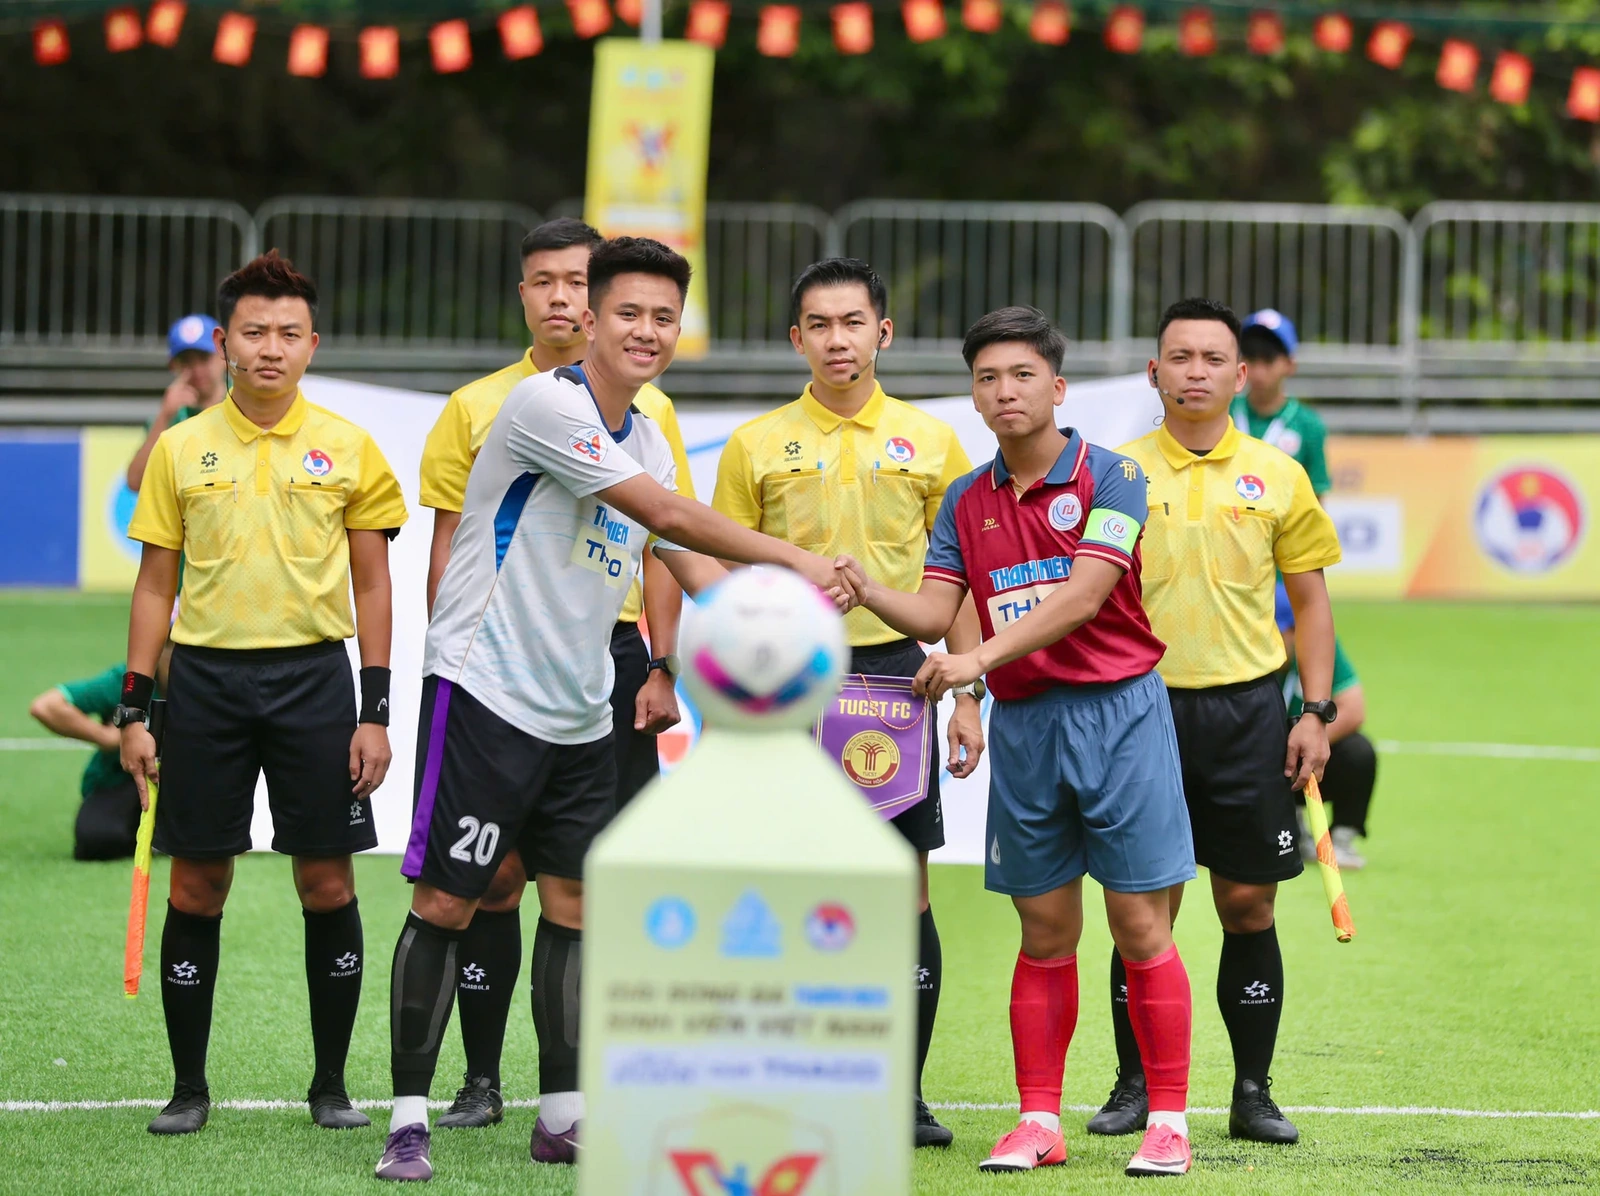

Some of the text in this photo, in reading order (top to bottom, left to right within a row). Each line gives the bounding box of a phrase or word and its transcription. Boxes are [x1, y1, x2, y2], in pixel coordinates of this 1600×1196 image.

[989, 560, 1038, 592] THANH
[998, 597, 1041, 622] TH
[838, 699, 911, 719] TUCST FC
[449, 815, 500, 866] 20
